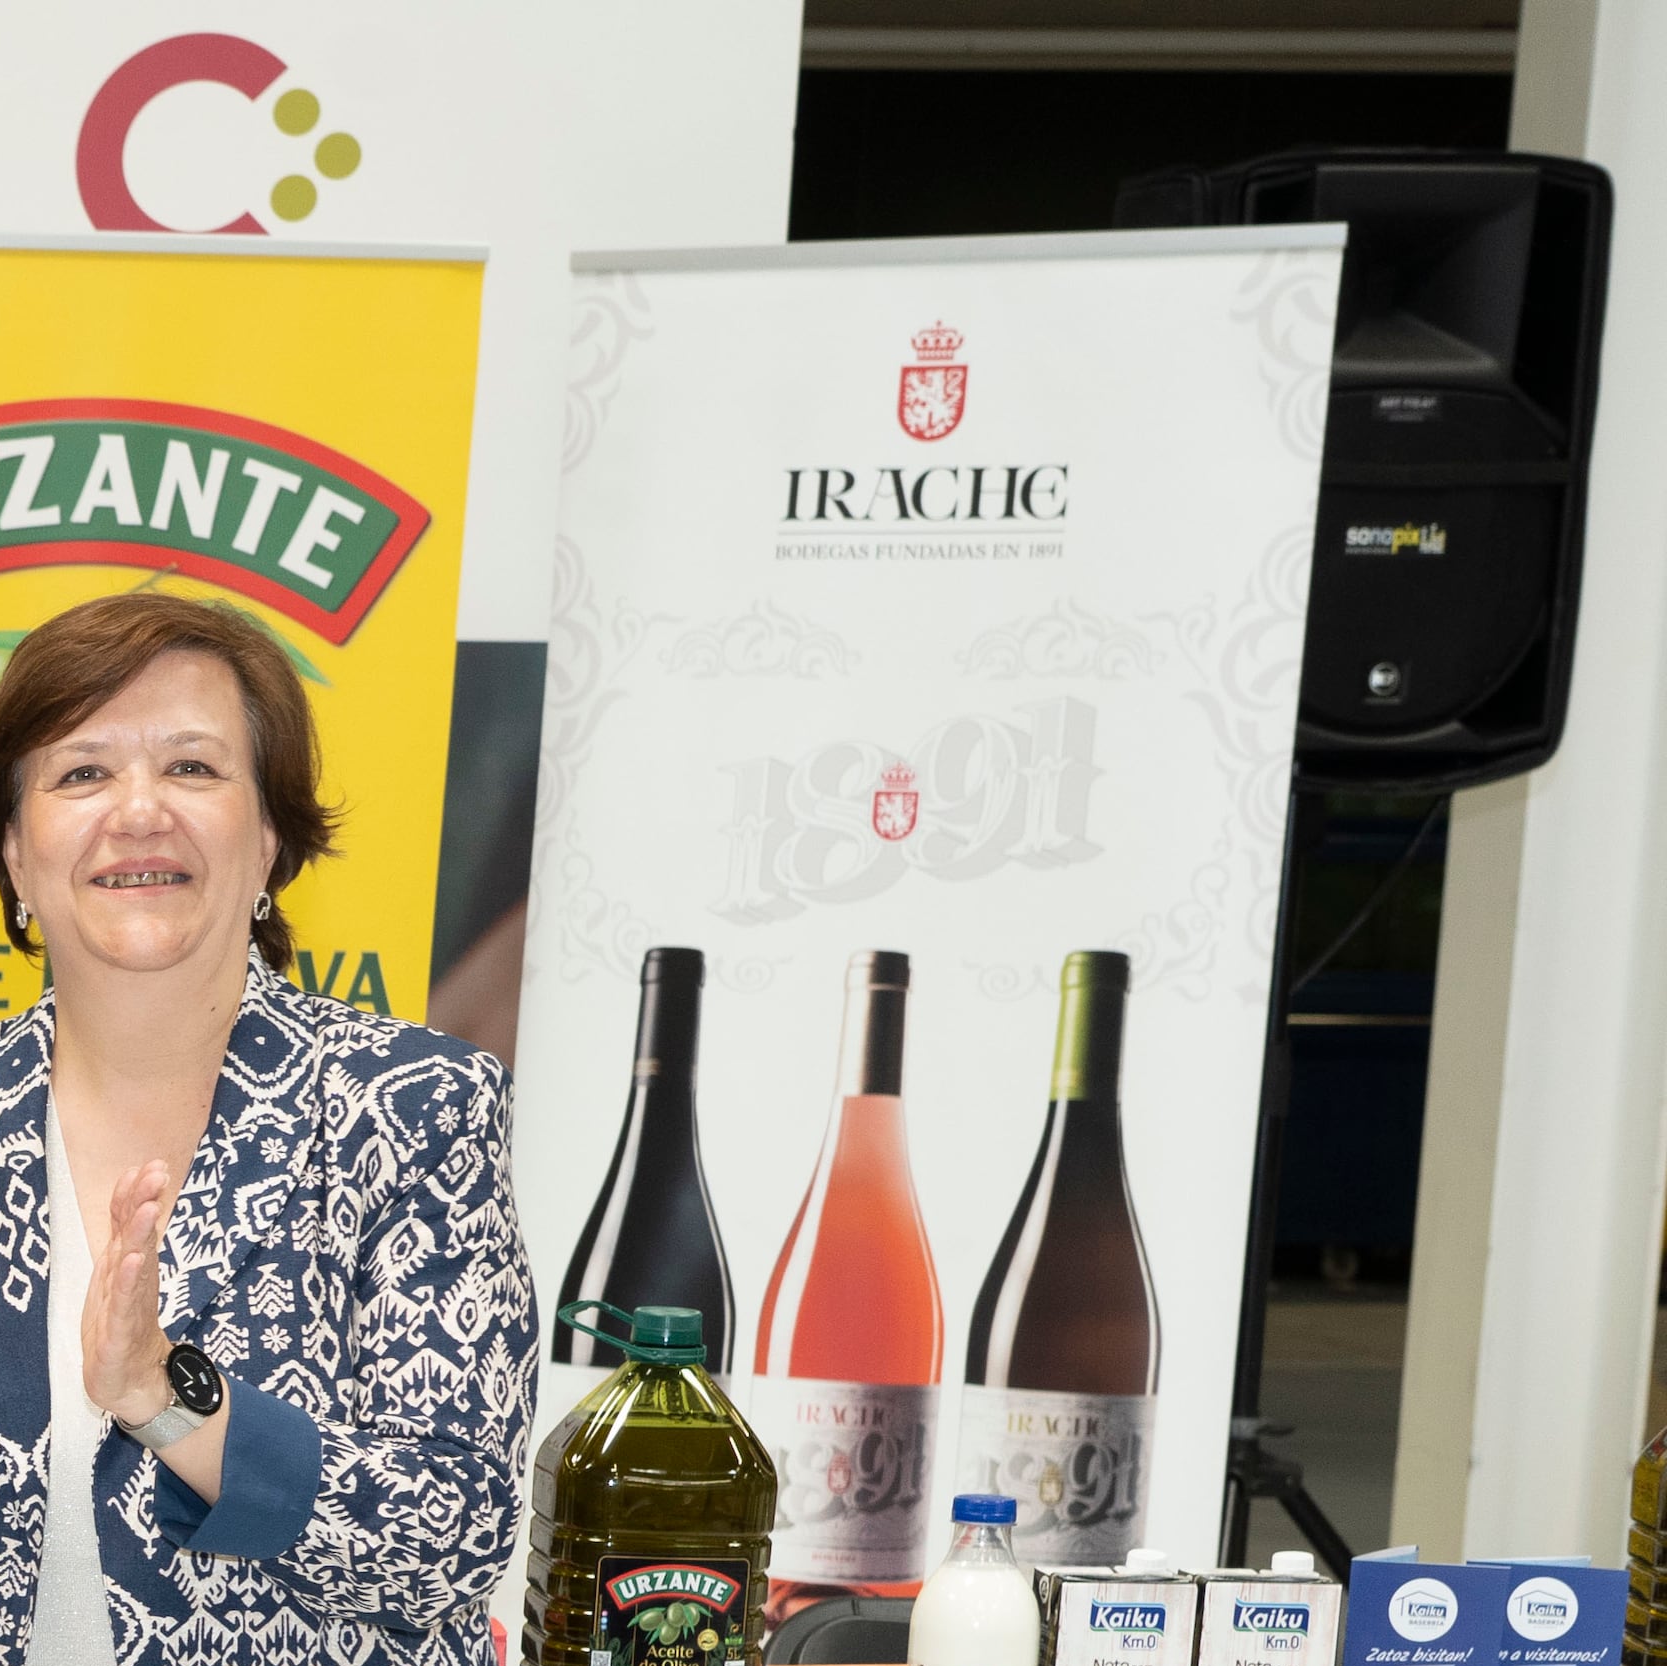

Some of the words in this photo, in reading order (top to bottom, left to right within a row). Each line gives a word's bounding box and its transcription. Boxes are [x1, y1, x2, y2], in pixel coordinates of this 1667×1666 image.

[781, 464, 1069, 522] IRACHE
[775, 543, 869, 561] BODEGAS
[875, 543, 987, 561] FUNDADAS
[993, 543, 1020, 560] EN
[1028, 542, 1065, 559] 1891
[618, 1572, 729, 1603] URZANTE
[1410, 1604, 1445, 1617] Kaiku
[1530, 1603, 1564, 1617] Kaiku
[1094, 1606, 1159, 1631] Kaiku
[1237, 1606, 1303, 1631] Kaiku
[1121, 1634, 1157, 1649] Km.0
[1266, 1634, 1300, 1649] Km.0
[646, 1645, 694, 1658] Aceite
[1366, 1648, 1409, 1662] Zatoz
[1412, 1648, 1473, 1662] bisitan!
[1510, 1651, 1522, 1661] a
[1525, 1648, 1608, 1662] visitarnos!
